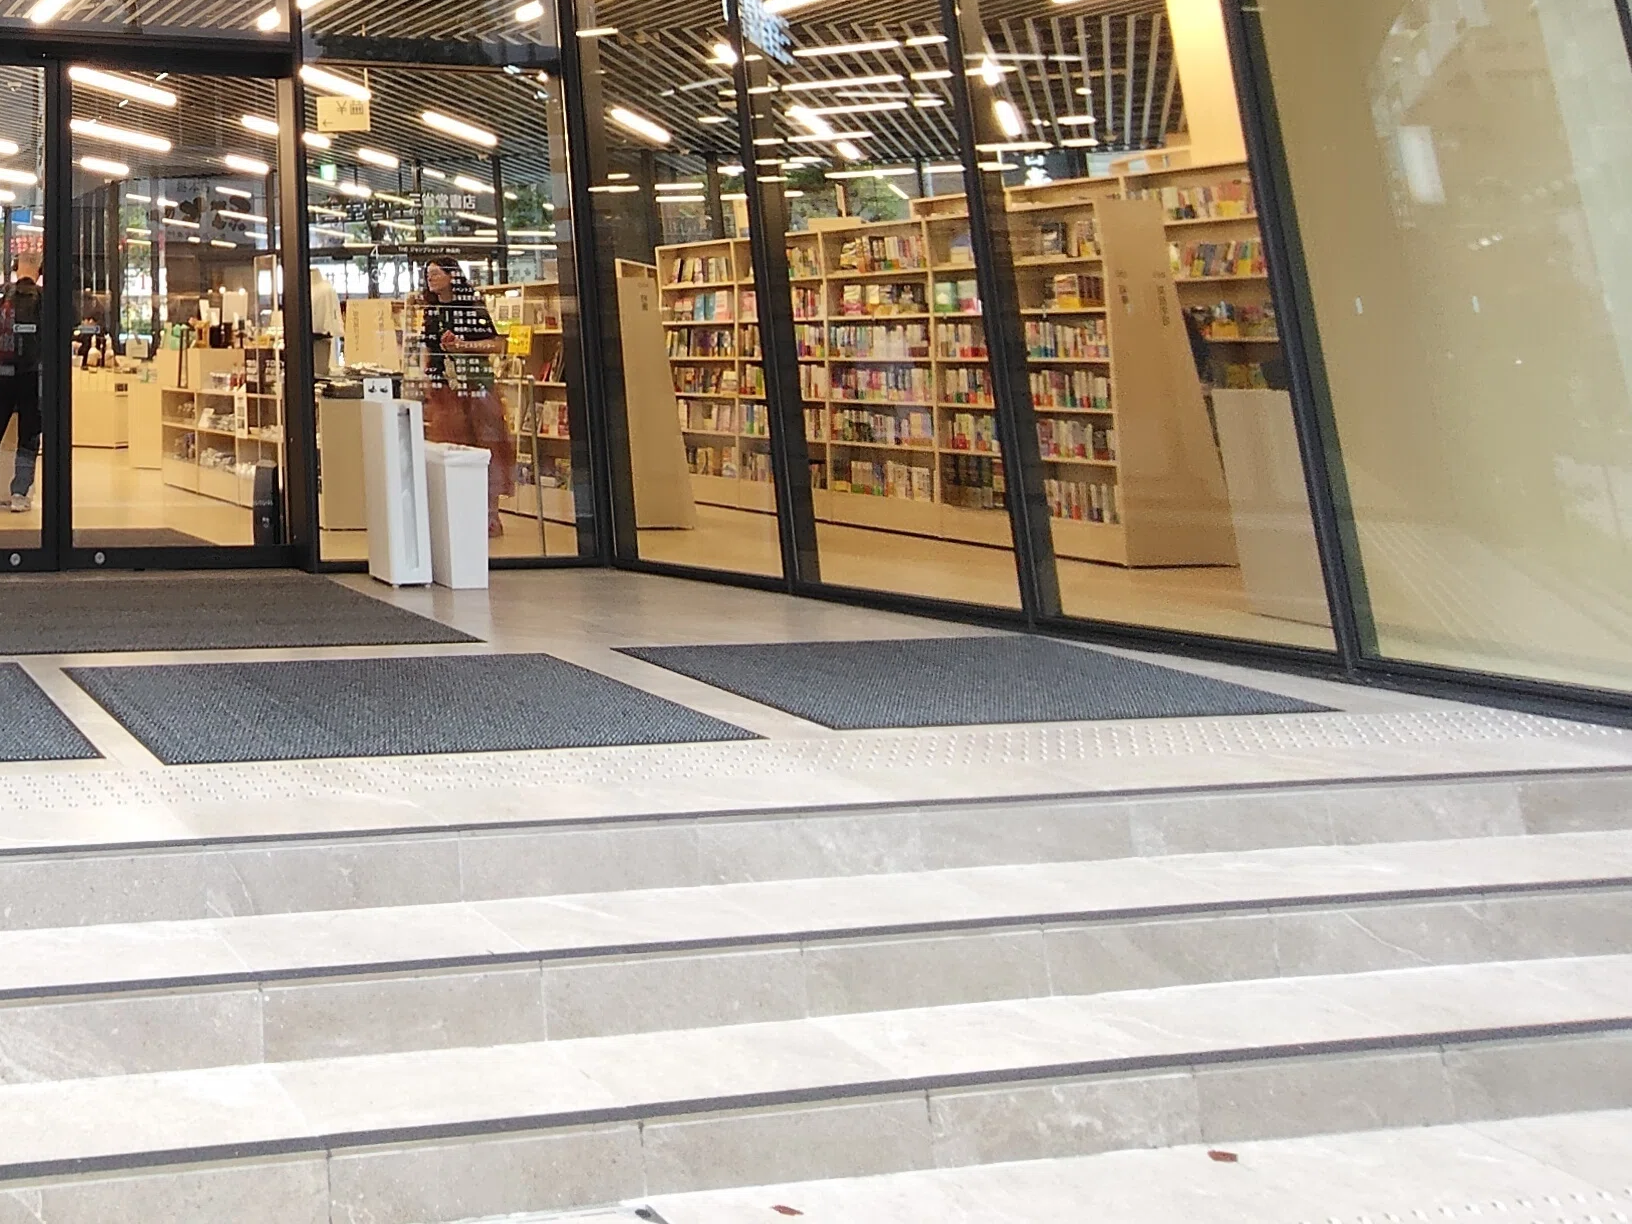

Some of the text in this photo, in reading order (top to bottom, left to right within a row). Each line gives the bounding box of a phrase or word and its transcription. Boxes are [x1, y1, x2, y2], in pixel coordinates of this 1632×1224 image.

[409, 192, 477, 210] 三省堂書店
